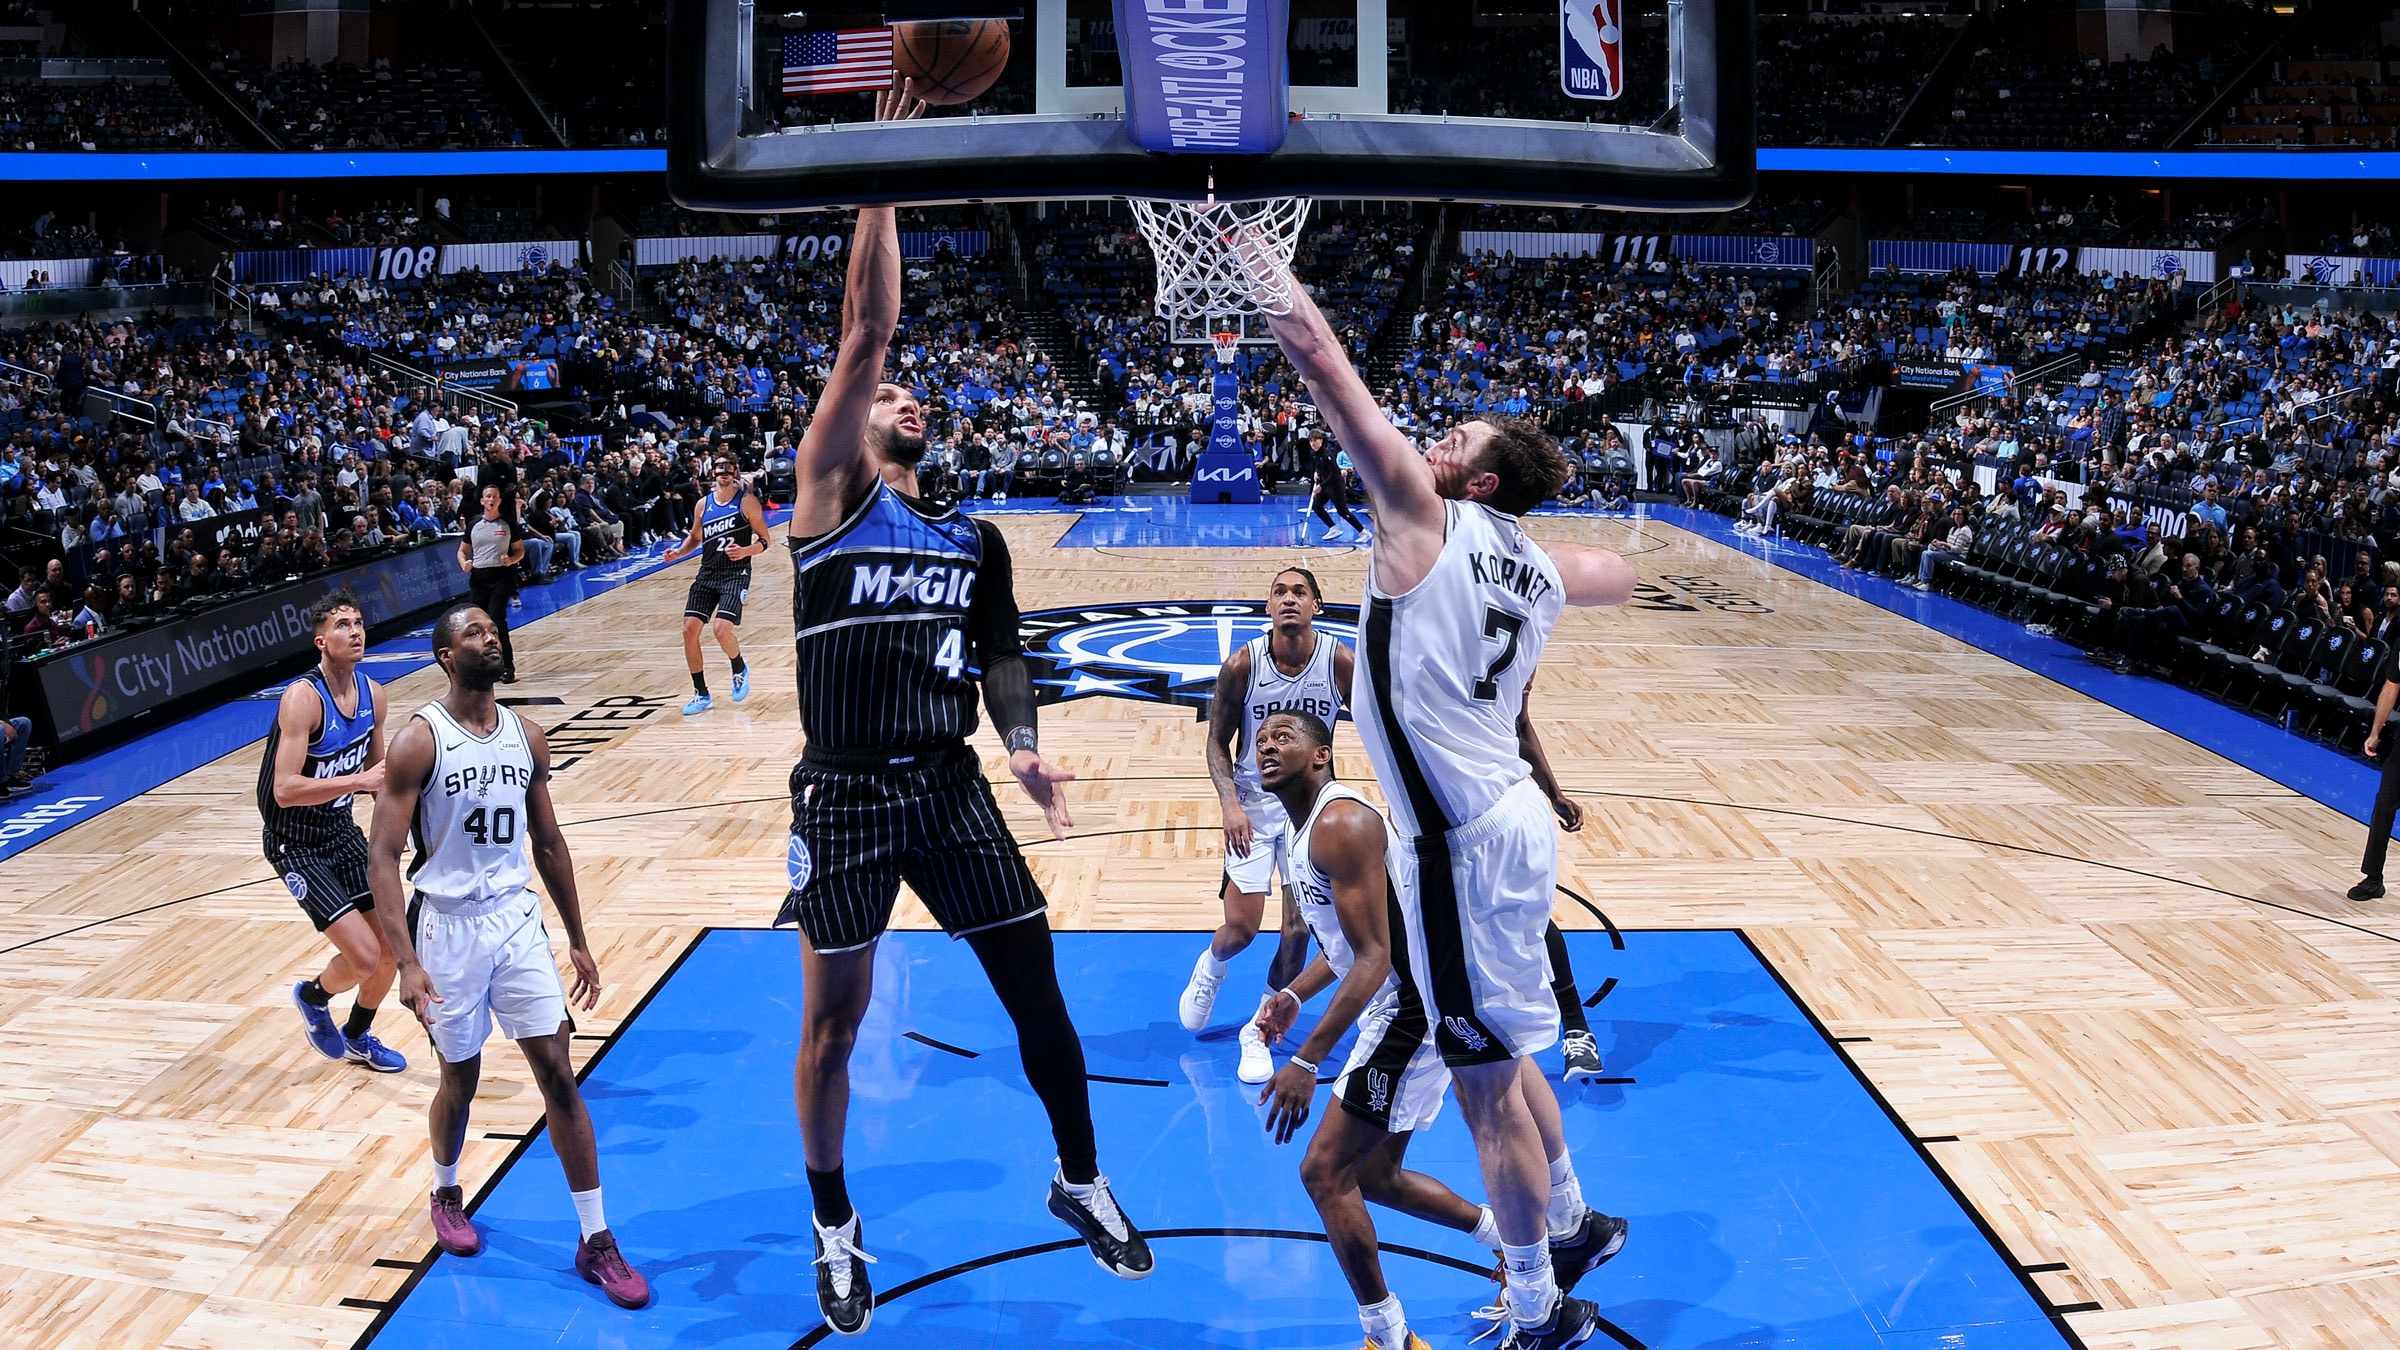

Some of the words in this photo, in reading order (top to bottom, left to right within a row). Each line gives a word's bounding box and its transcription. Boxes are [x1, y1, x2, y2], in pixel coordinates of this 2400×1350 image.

[1571, 67, 1600, 90] NBA
[378, 246, 436, 280] 108
[784, 235, 842, 261] 109
[1613, 235, 1659, 264] 111
[2018, 247, 2069, 278] 112
[444, 371, 459, 381] City
[460, 369, 489, 378] National
[490, 368, 507, 376] Bank
[533, 378, 540, 388] 6
[1901, 365, 1914, 375] City
[1915, 366, 1943, 376] National
[1944, 368, 1960, 377] Bank
[703, 516, 736, 539] MAGIC
[849, 558, 977, 609] MAGIC
[1469, 551, 1552, 609] KORNET
[1659, 574, 1775, 613] CENTER
[114, 652, 174, 696] City
[175, 608, 285, 677] National
[282, 602, 313, 638] Ba
[934, 628, 965, 680] 4
[1470, 601, 1529, 706] 7
[545, 694, 681, 774] NTER
[444, 764, 529, 798] SPURS
[462, 804, 515, 847] 40
